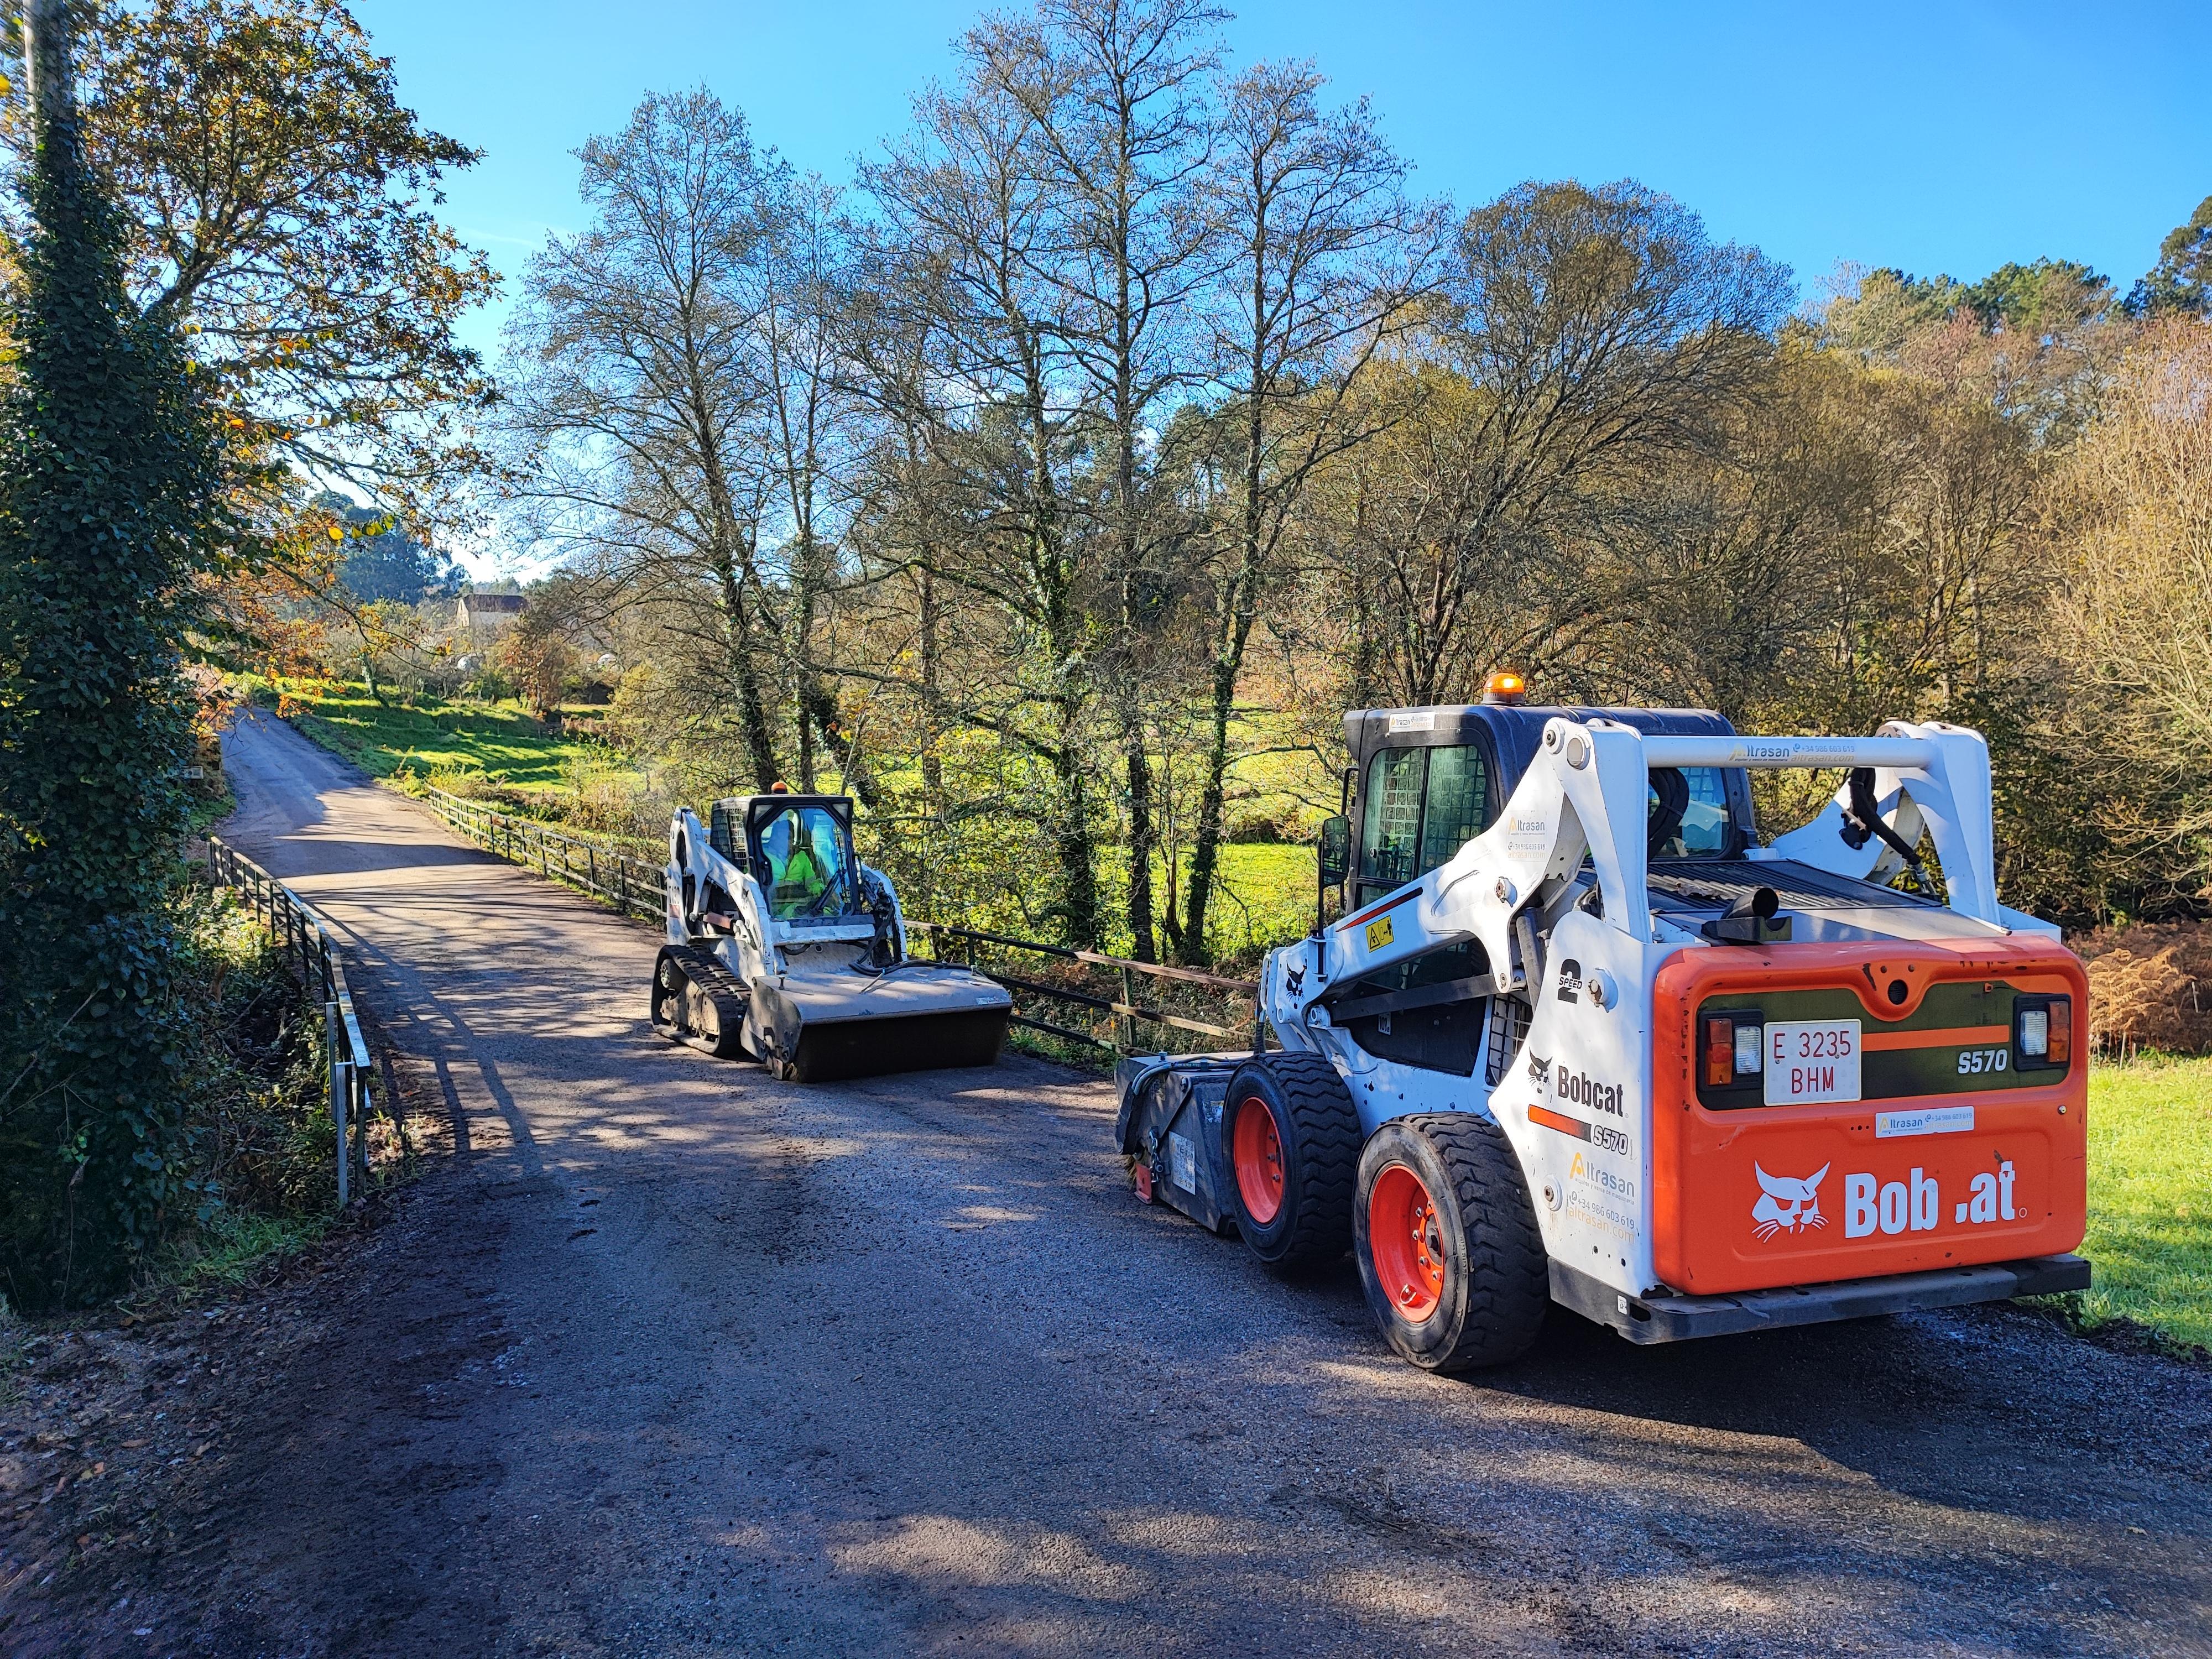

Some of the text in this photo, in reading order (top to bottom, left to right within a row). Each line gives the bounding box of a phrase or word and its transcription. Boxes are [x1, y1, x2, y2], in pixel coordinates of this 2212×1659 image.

[1729, 743, 1790, 760] Altrasan
[1791, 754, 1854, 762] altrasan.com
[1508, 817, 1545, 835] Altrasan
[1557, 958, 1581, 1004] 2
[1559, 977, 1583, 989] SPEED
[1379, 1016, 1387, 1031] 101
[1774, 1030, 1851, 1059] E 3235
[1958, 1049, 2007, 1074] S570
[1558, 1065, 1624, 1118] Bobcat
[1792, 1066, 1834, 1094] BHM
[1879, 1116, 1923, 1133] Altrasan
[1593, 1125, 1628, 1155] S570
[1569, 1152, 1635, 1197] Altrasan
[1569, 1205, 1635, 1244] altrasan.com
[1578, 1198, 1635, 1229] +34 986 603 619
